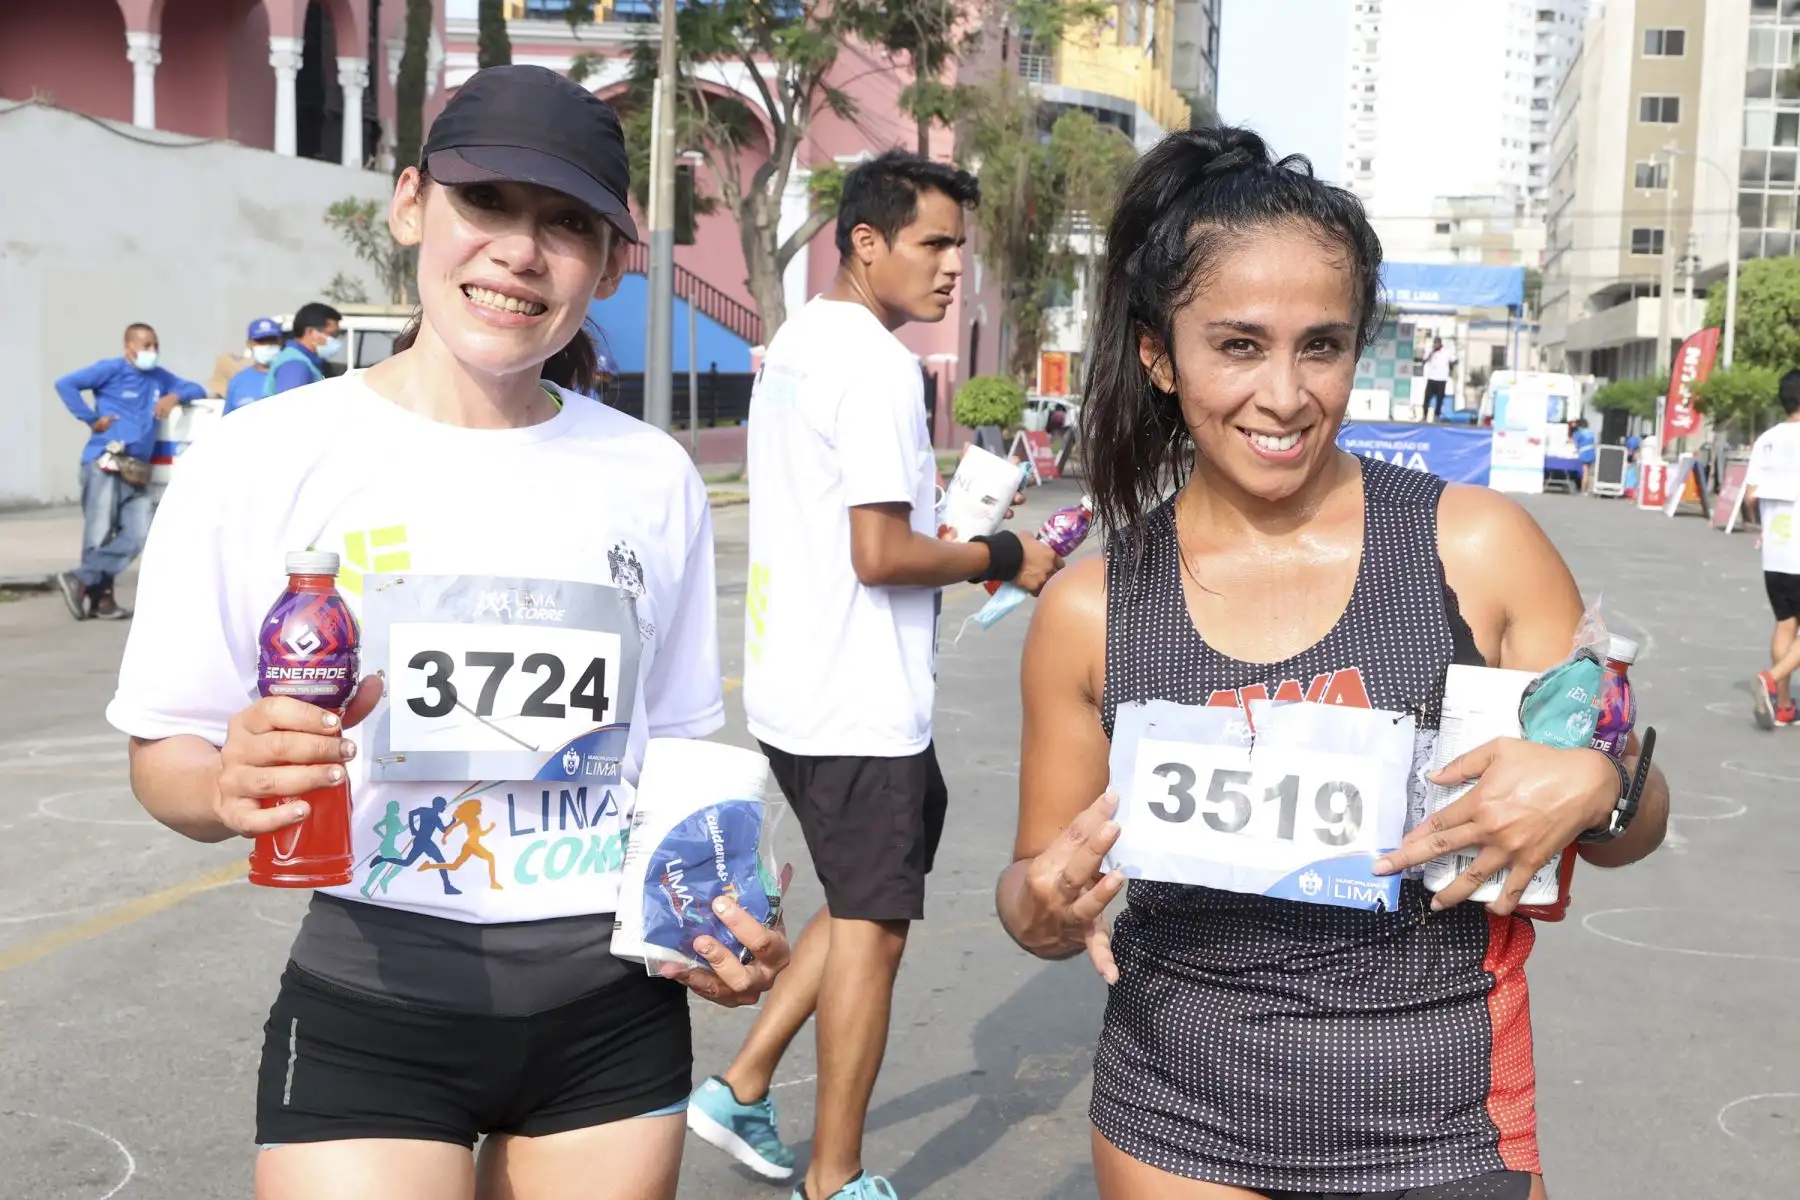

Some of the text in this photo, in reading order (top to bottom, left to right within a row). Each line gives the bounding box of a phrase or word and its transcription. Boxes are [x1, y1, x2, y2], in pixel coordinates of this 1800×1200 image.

[515, 607, 566, 621] CORRE
[265, 666, 346, 679] GENERADE
[407, 650, 609, 723] 3724
[585, 761, 617, 777] LIMA
[1147, 762, 1364, 847] 3519
[665, 858, 694, 912] LIMA
[1334, 883, 1391, 911] LIMA
